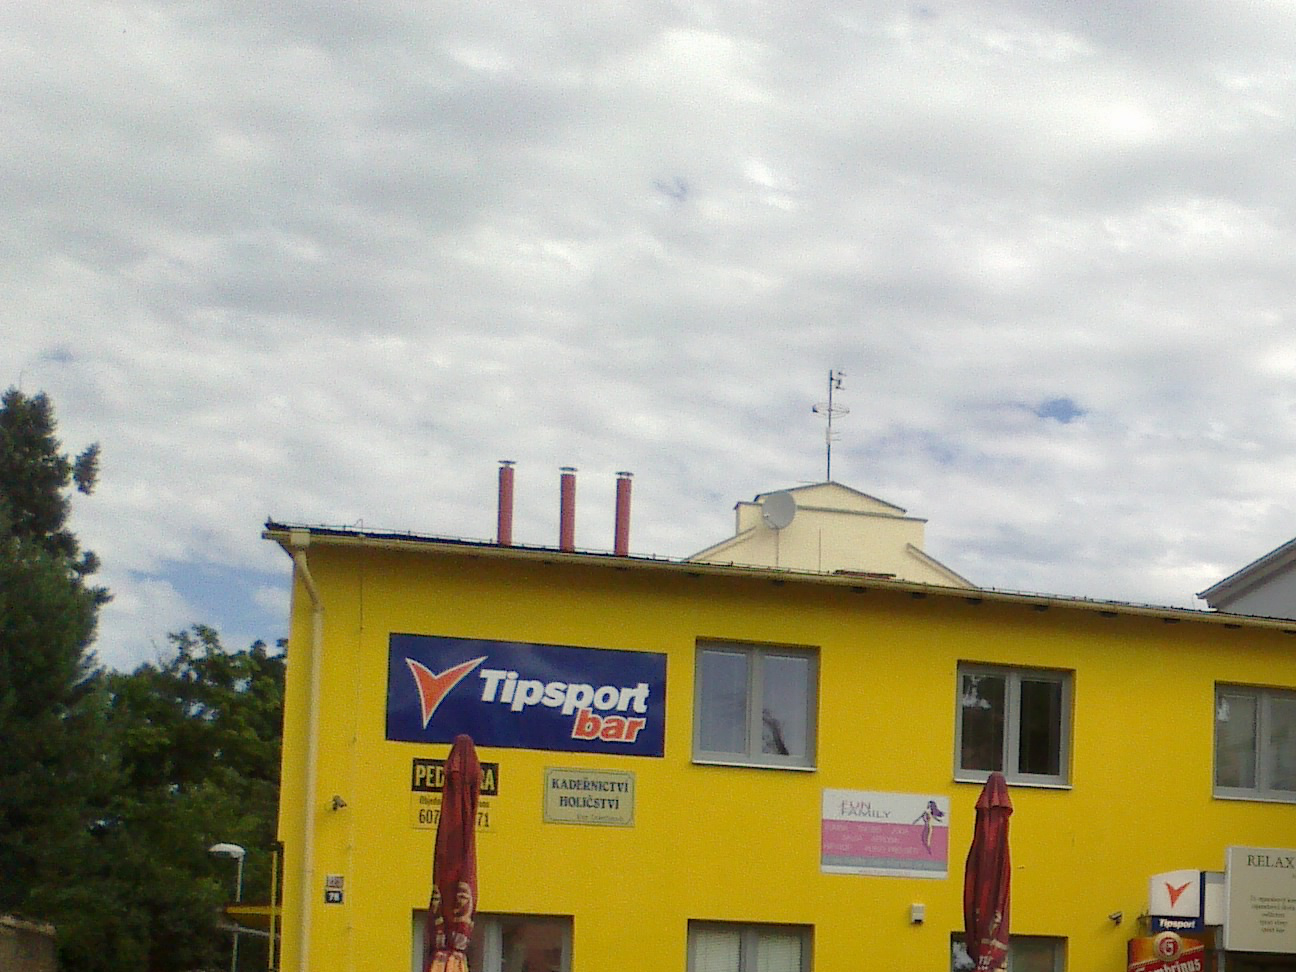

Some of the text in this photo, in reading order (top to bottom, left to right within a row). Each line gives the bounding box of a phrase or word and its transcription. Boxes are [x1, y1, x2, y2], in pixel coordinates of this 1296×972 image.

[479, 668, 650, 716] Tipsport
[572, 707, 647, 743] bar
[551, 776, 629, 793] KADEŘNICTVÍ
[559, 794, 620, 810] HOLIČSTVÍ
[841, 799, 871, 810] FUN
[841, 808, 892, 819] FAMILY
[1247, 854, 1296, 869] RELAX
[1159, 918, 1196, 930] Tipsport
